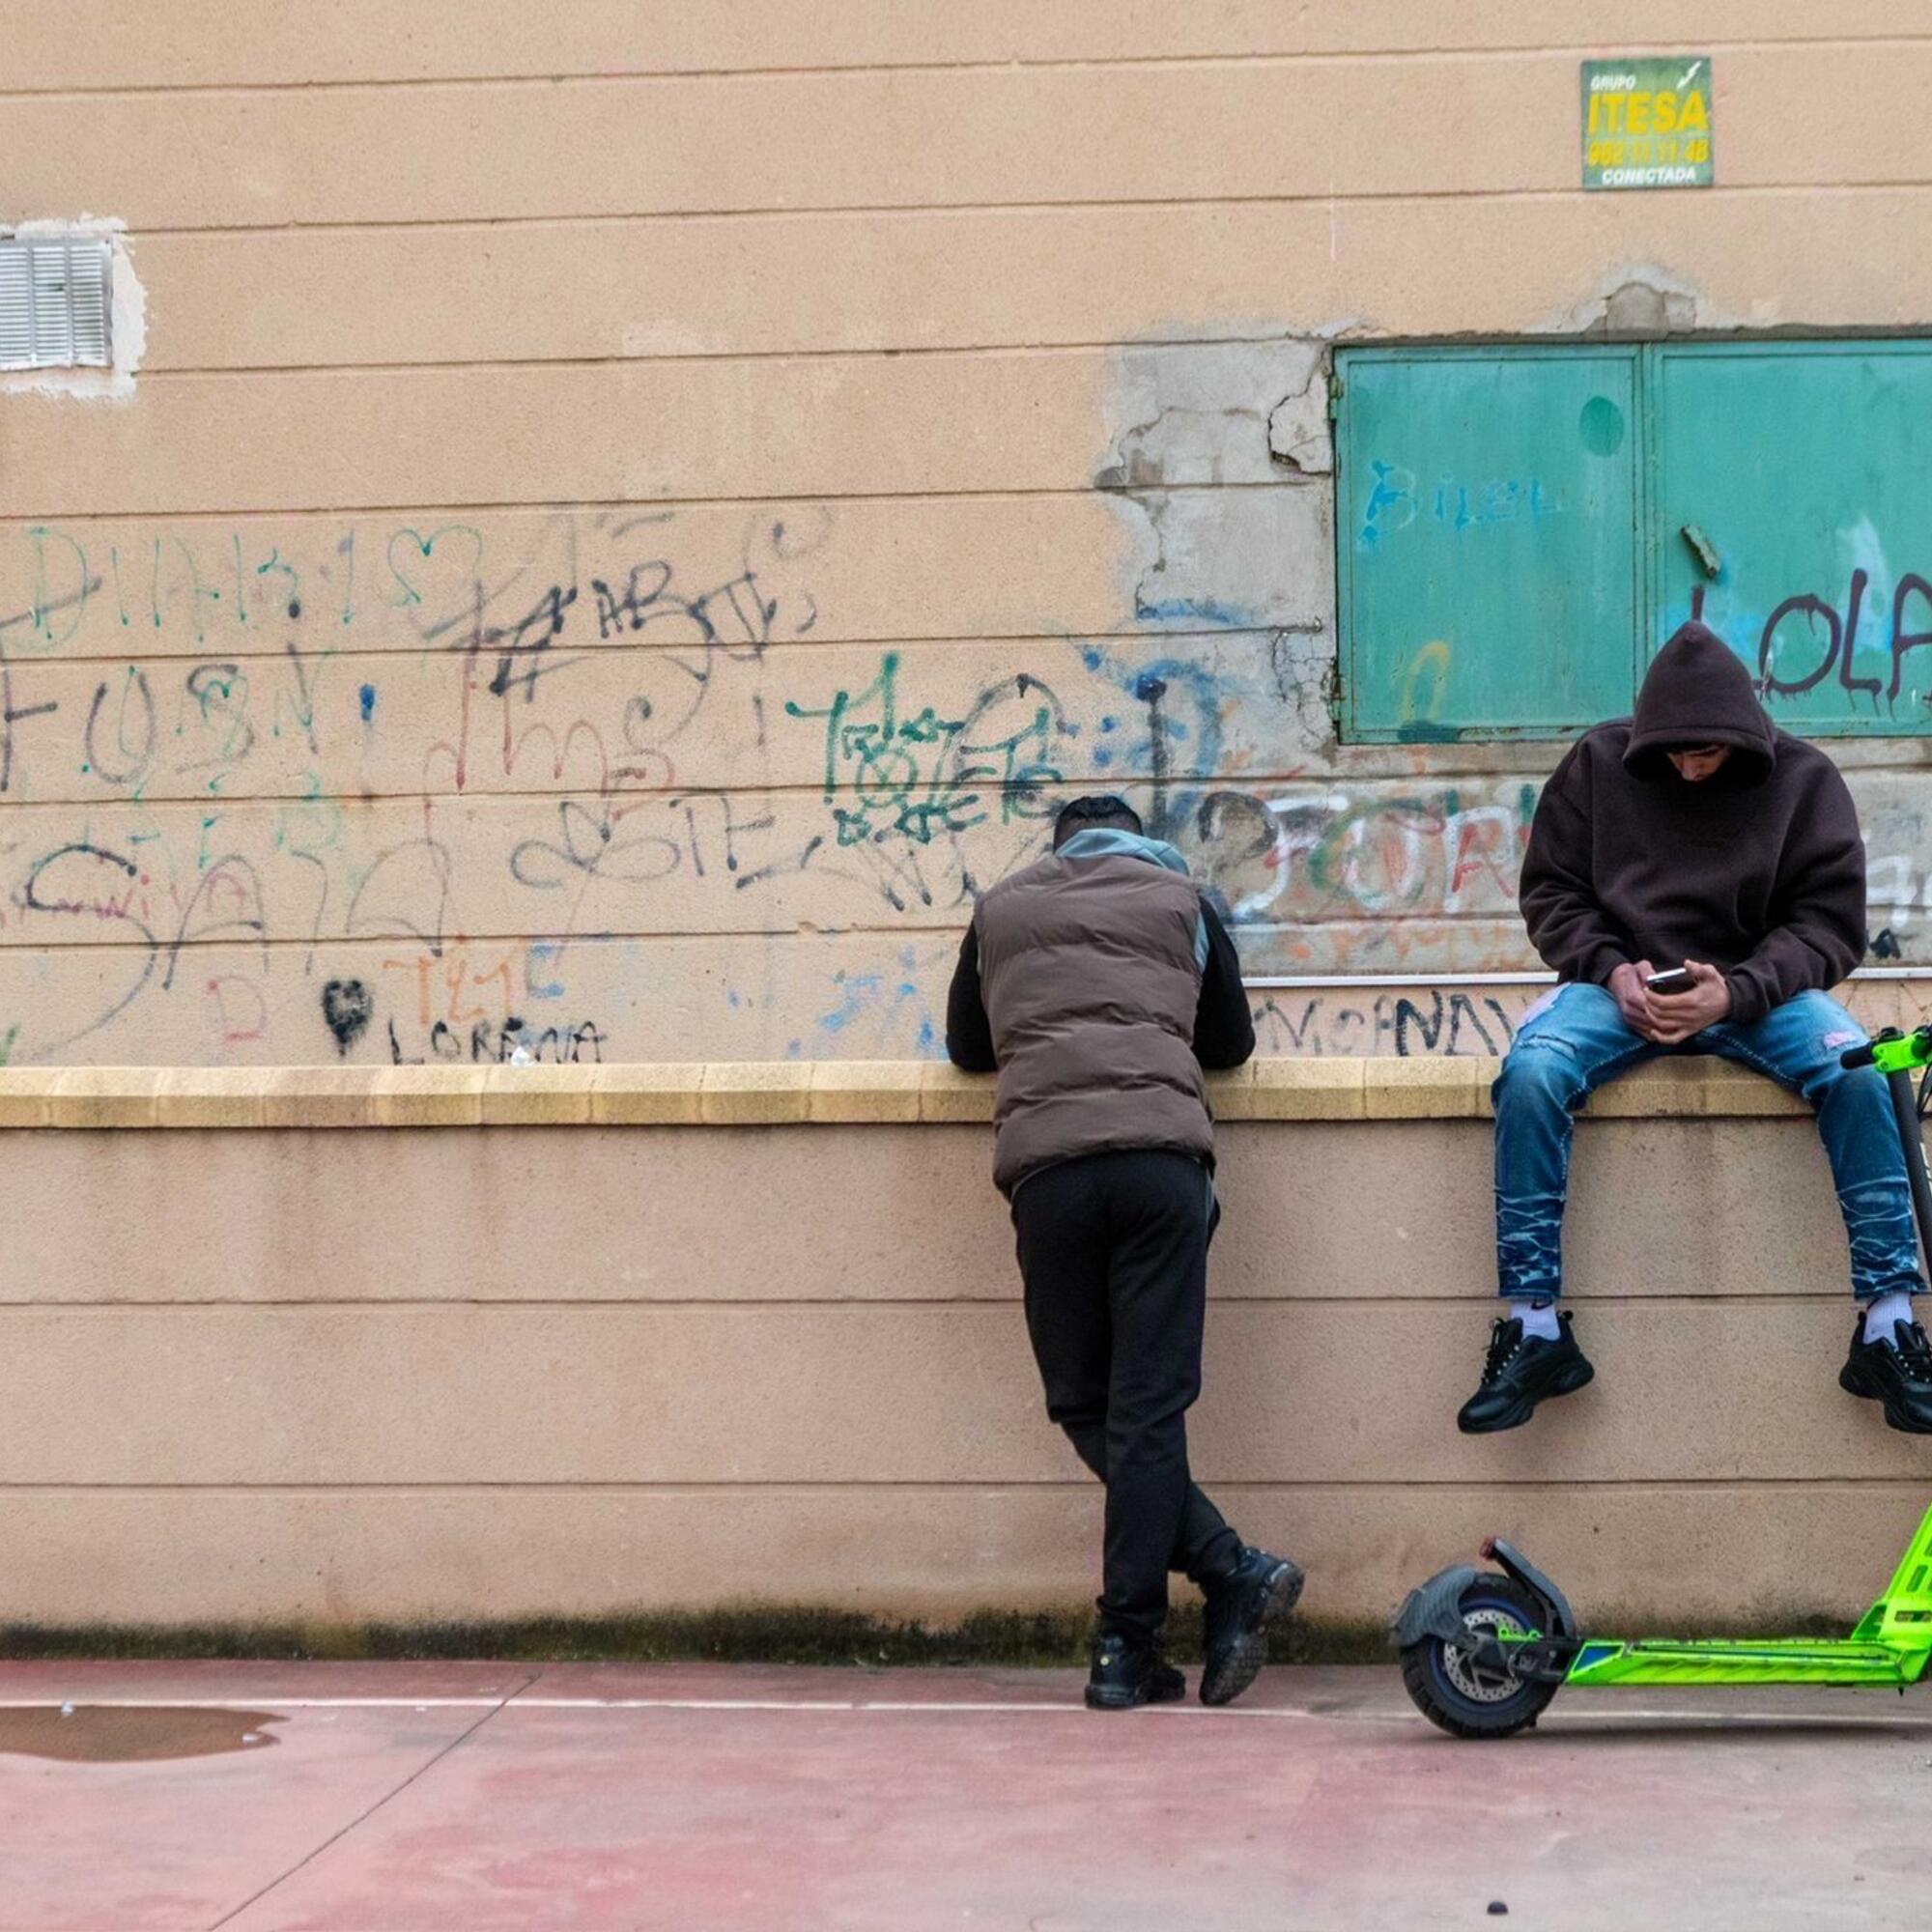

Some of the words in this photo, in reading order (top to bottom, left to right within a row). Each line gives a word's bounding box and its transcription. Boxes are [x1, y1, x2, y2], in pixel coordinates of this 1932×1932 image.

[1590, 74, 1636, 91] GRUPO
[1587, 90, 1709, 136] ITESA
[1601, 166, 1696, 186] CONECTADA
[1691, 568, 1932, 707] OLA
